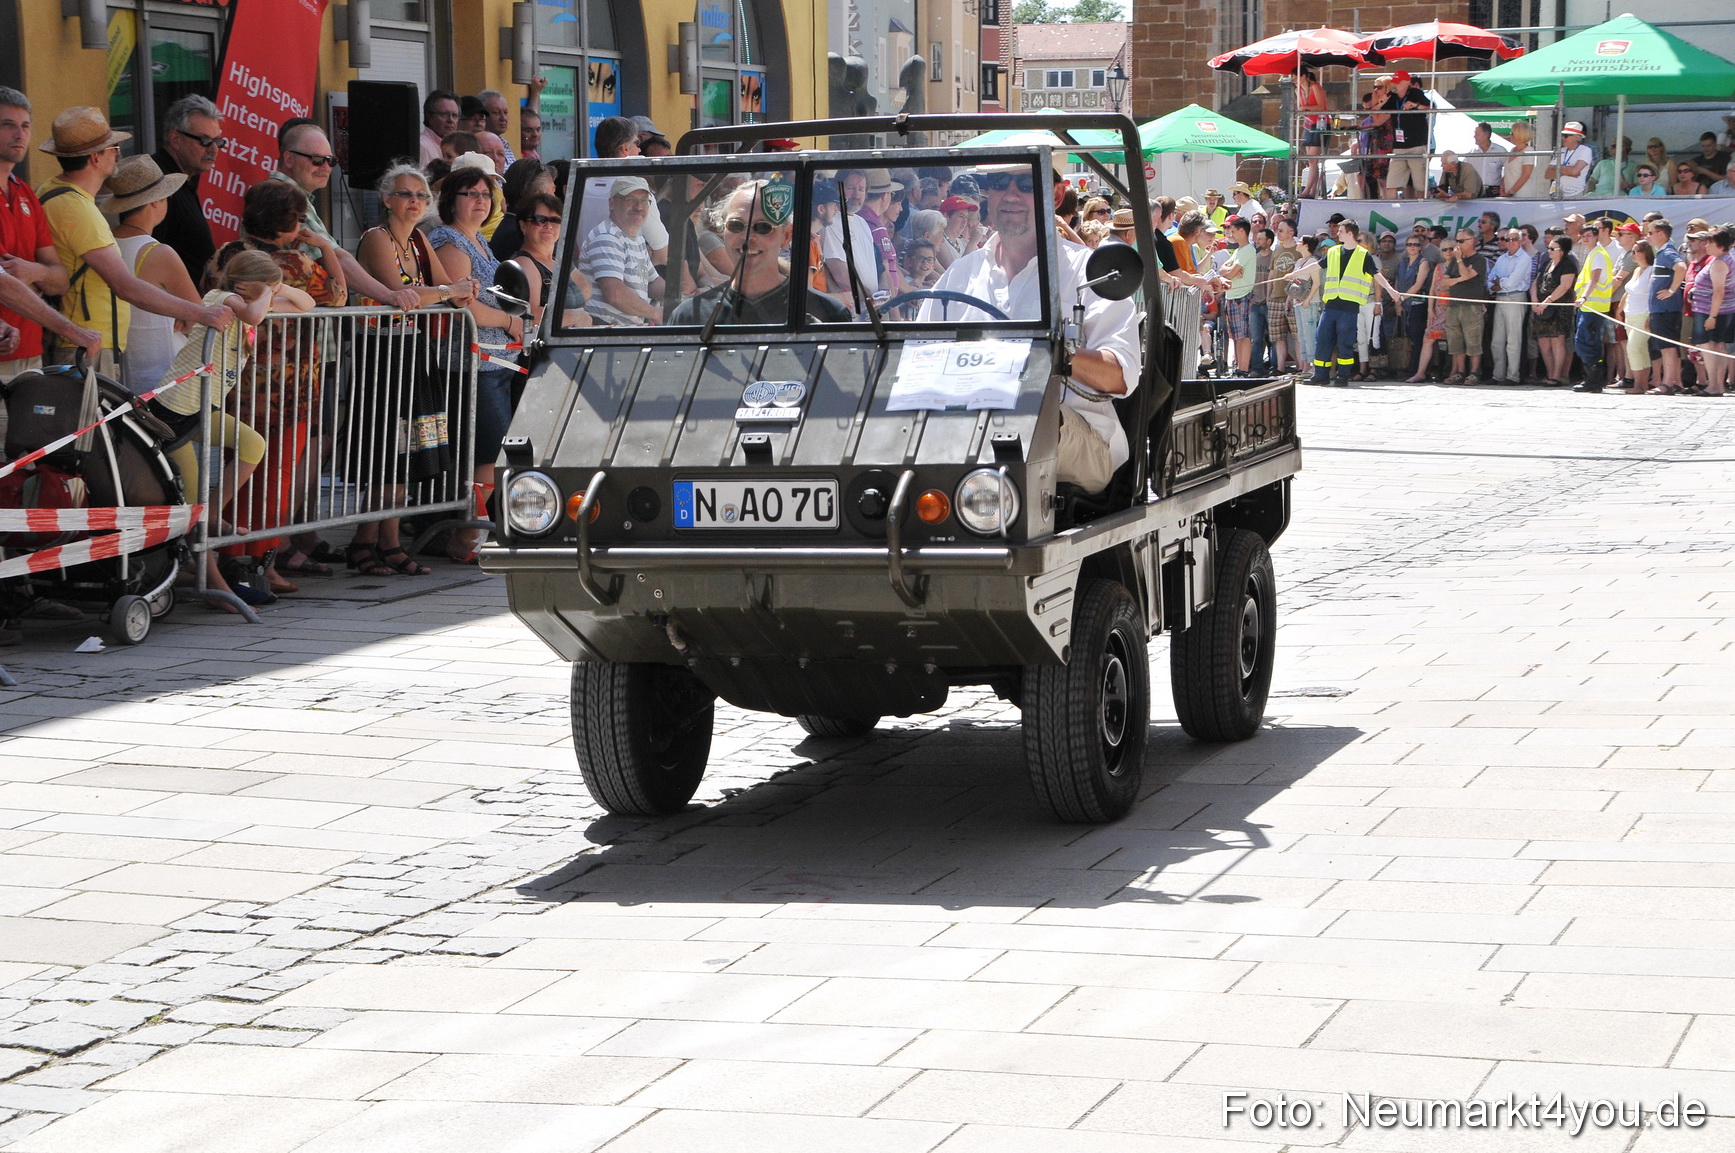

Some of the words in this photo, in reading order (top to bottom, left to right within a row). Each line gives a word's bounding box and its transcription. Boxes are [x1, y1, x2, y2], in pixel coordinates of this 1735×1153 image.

[1550, 64, 1661, 73] Lammsbräu
[229, 61, 308, 118] Highspeed
[222, 95, 279, 138] Intern
[218, 137, 259, 166] etzt
[208, 164, 223, 188] in
[226, 171, 252, 198] Ih
[202, 197, 242, 232] Gem
[956, 352, 997, 368] 692
[680, 509, 688, 520] D
[695, 487, 717, 522] N
[739, 487, 783, 522] AO
[791, 487, 834, 522] 70
